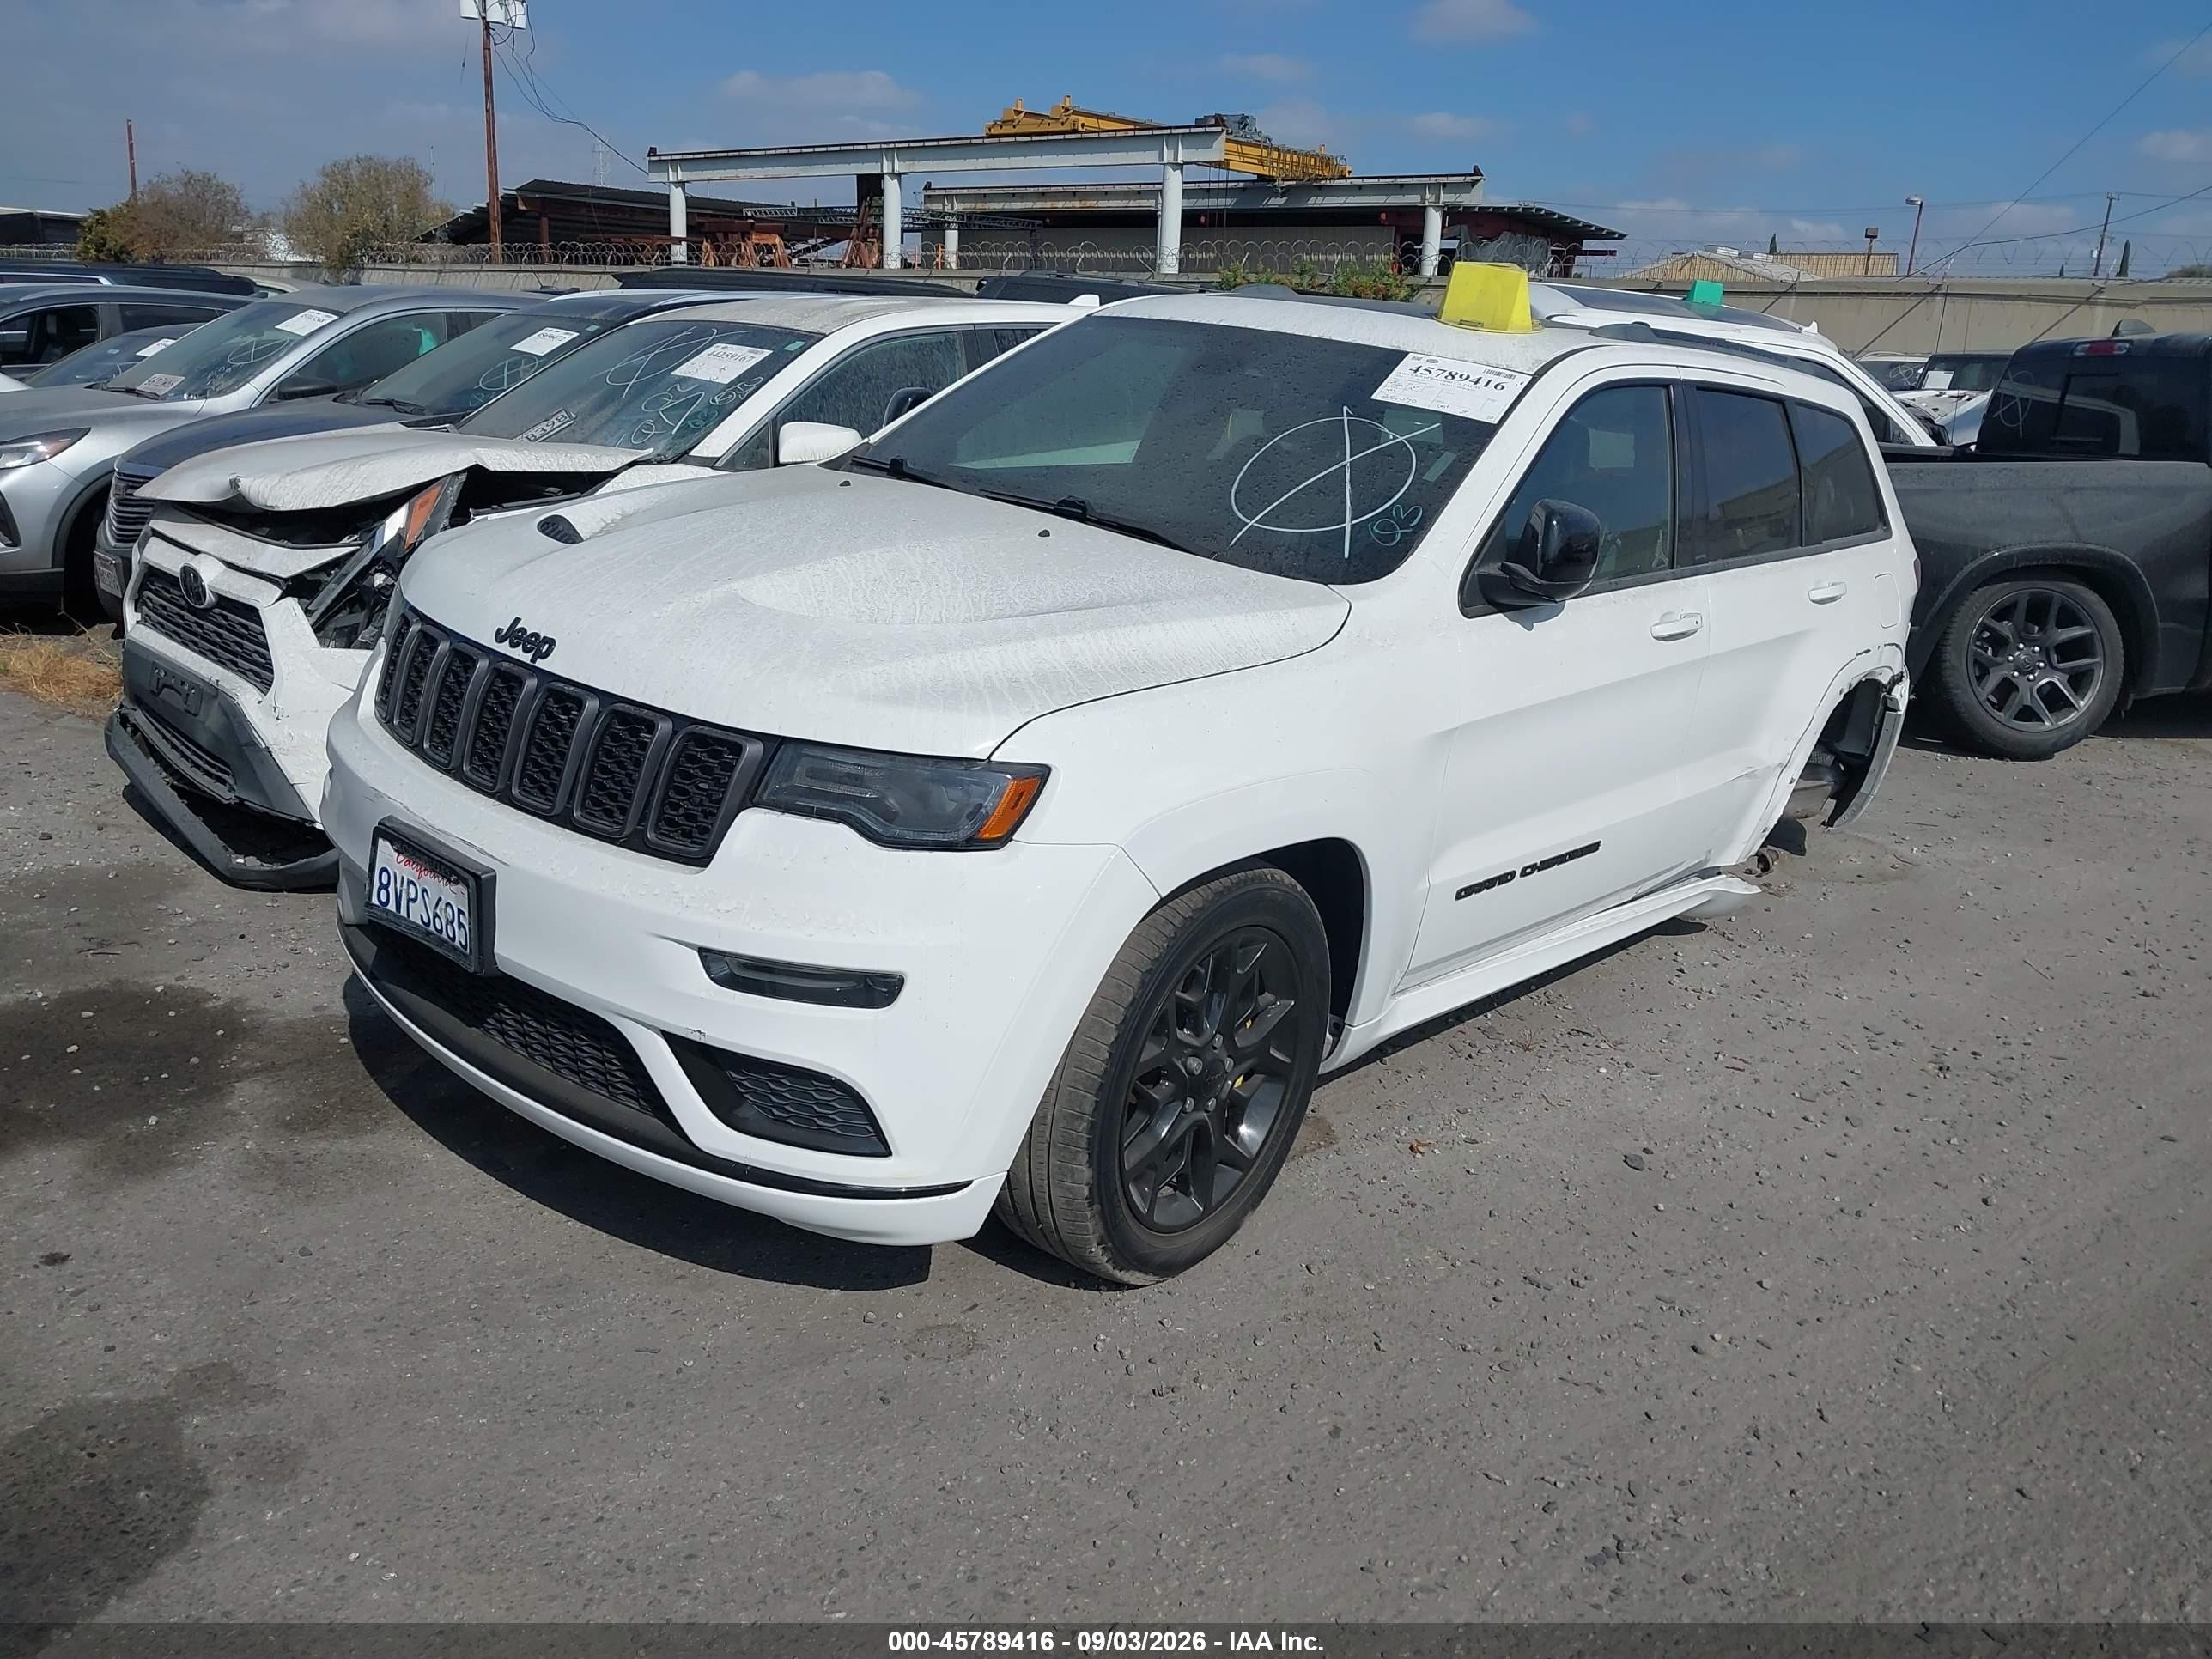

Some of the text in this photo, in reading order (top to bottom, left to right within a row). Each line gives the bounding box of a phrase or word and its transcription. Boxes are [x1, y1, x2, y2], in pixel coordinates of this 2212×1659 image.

[1408, 365, 1508, 392] 45789416
[495, 617, 556, 665] Jeep
[1455, 840, 1602, 901] GRAND CHEROKEE
[377, 866, 468, 951] 8VPS685
